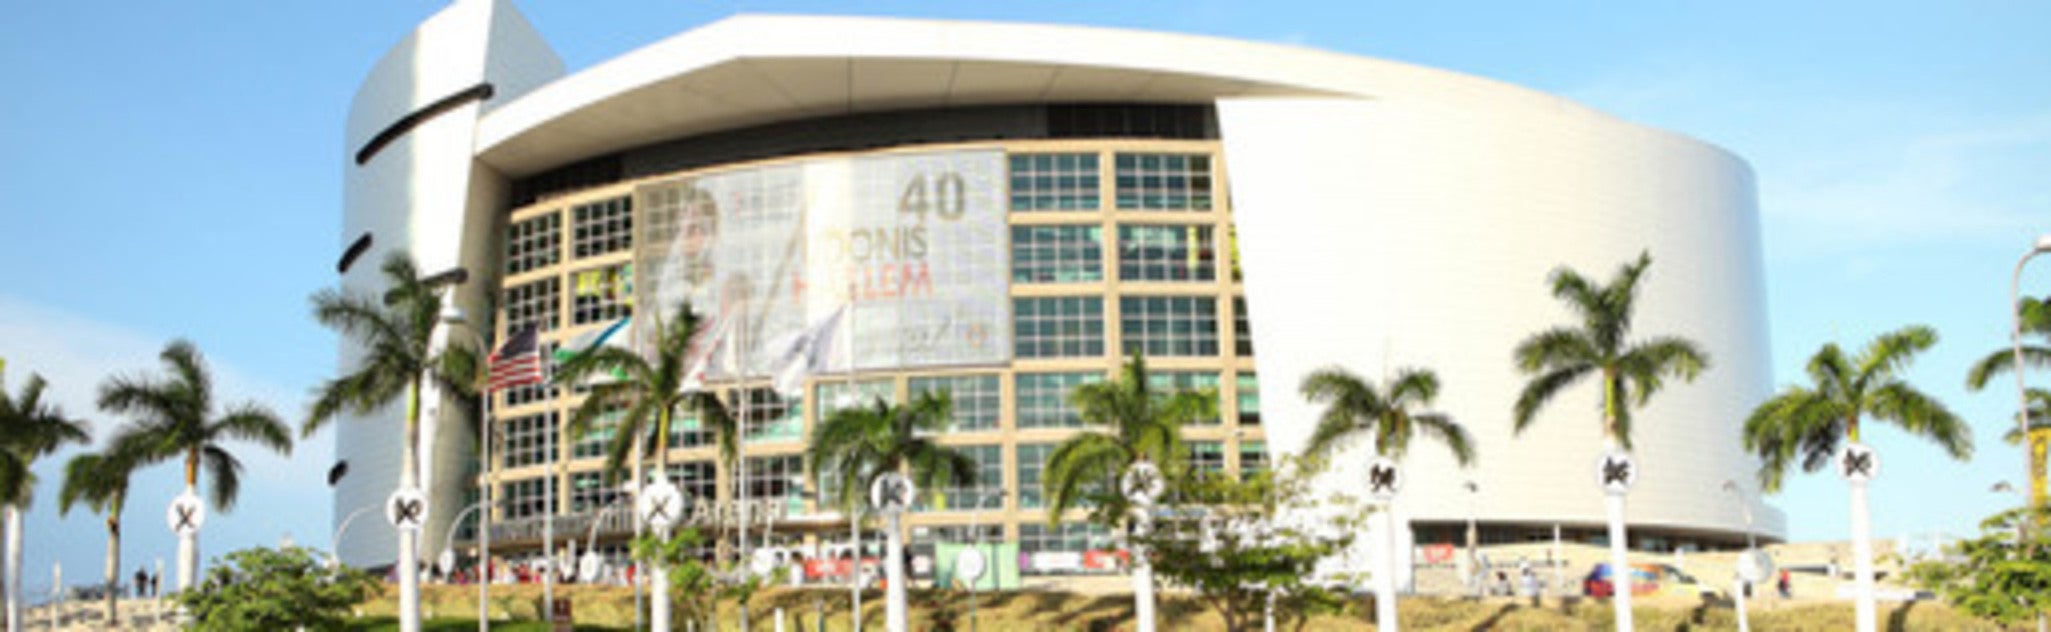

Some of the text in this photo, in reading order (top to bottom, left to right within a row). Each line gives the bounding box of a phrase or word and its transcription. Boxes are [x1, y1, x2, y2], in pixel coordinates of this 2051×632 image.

[899, 172, 966, 222] 40
[811, 225, 928, 262] DONIS
[791, 261, 934, 304] HLEM
